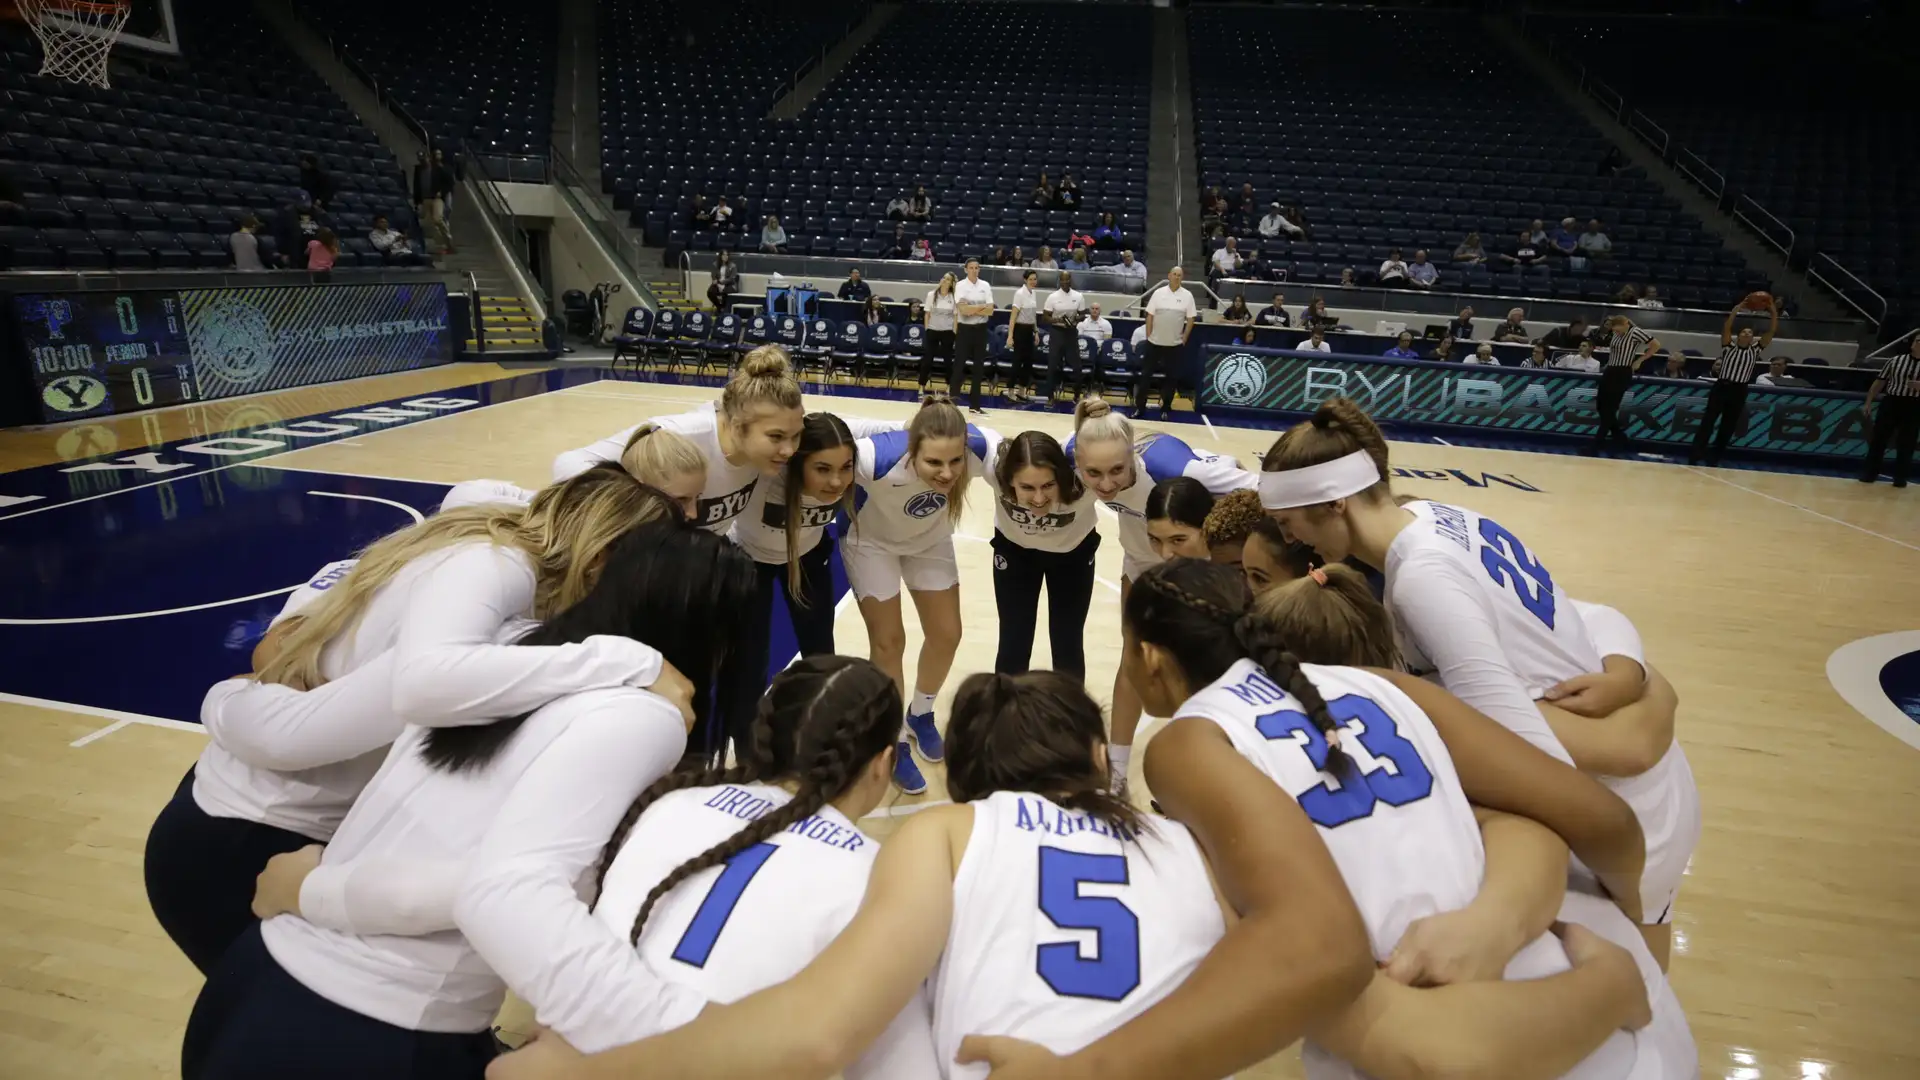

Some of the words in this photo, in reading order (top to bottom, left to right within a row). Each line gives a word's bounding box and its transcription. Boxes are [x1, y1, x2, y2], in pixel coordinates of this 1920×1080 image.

[115, 296, 139, 335] 0
[33, 343, 94, 374] 10:00
[131, 367, 154, 405] 0
[181, 381, 192, 400] 0
[58, 397, 480, 474] YOUNG
[706, 490, 750, 523] BYU
[800, 508, 834, 527] YU
[1012, 508, 1058, 527] BYU
[1478, 517, 1556, 632] 22
[1255, 692, 1434, 829] 33
[670, 841, 782, 970] 1
[1036, 845, 1141, 1003] 5
